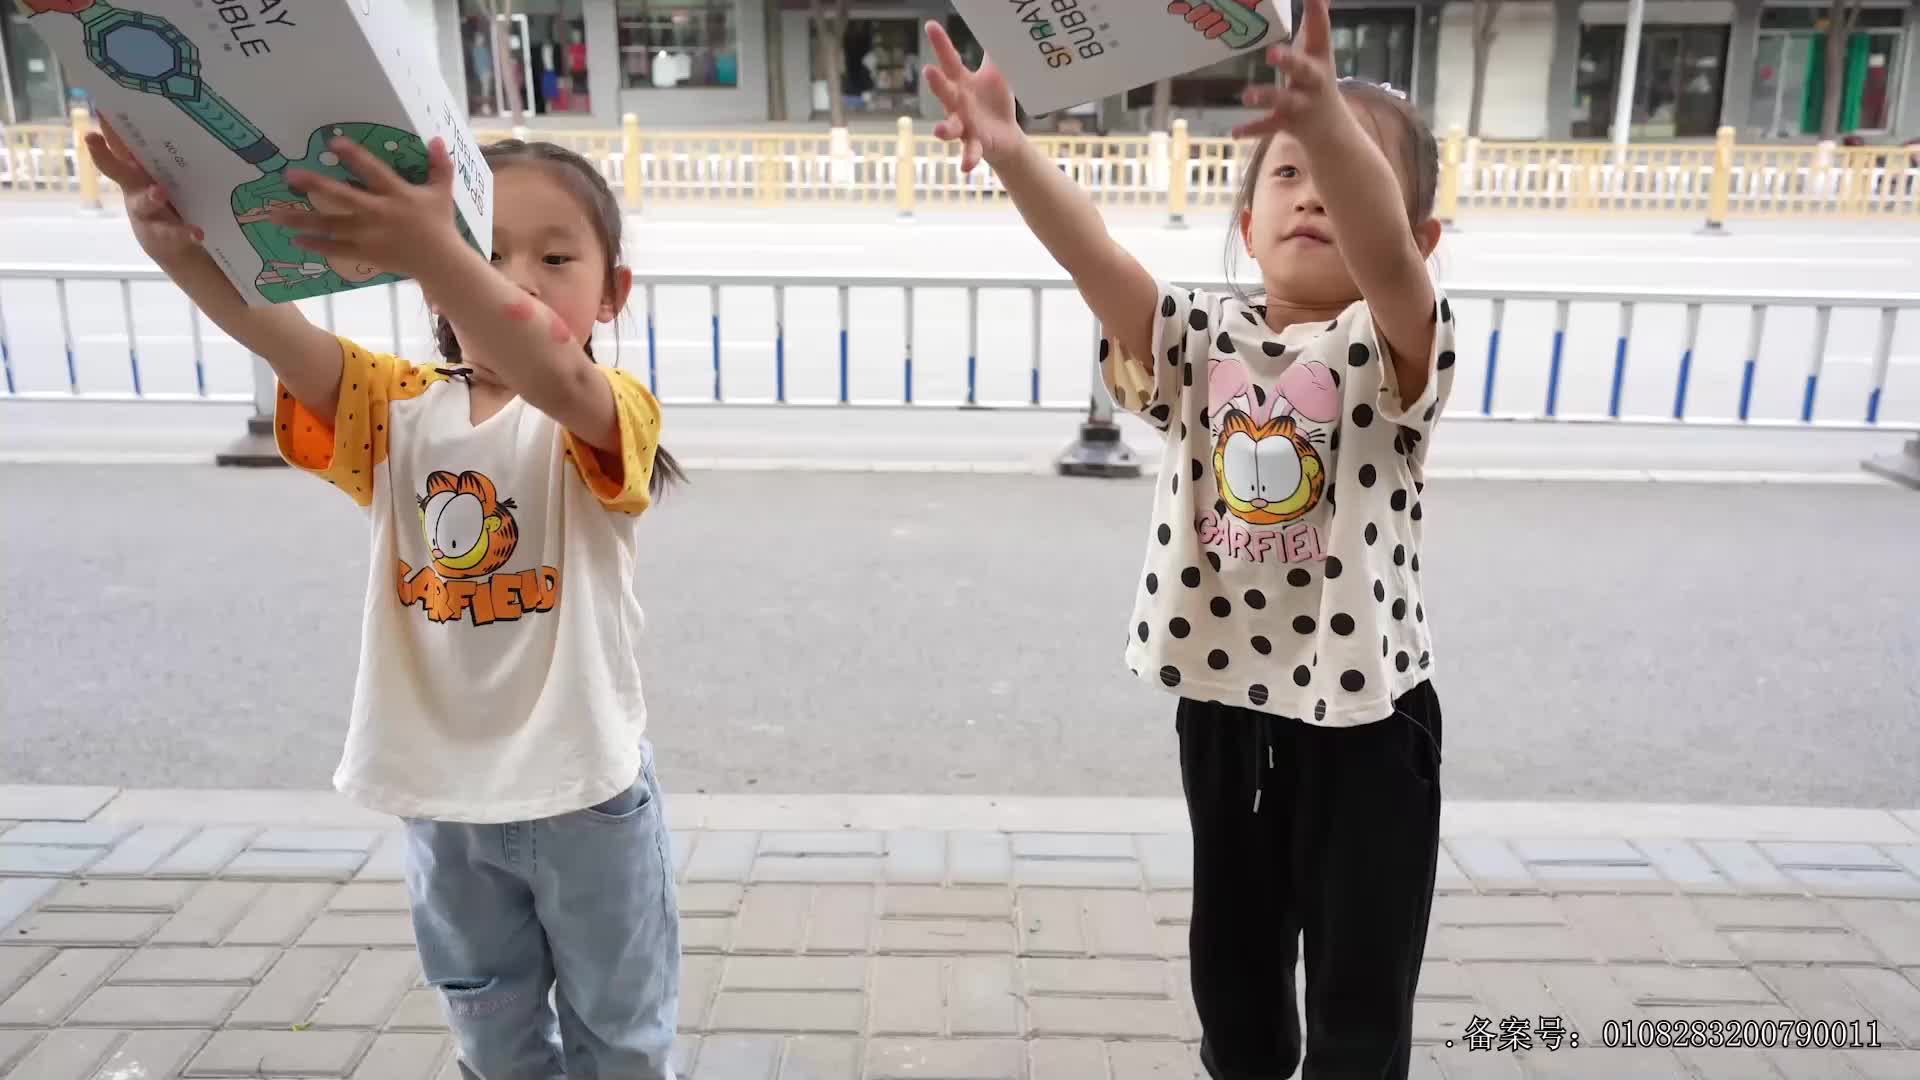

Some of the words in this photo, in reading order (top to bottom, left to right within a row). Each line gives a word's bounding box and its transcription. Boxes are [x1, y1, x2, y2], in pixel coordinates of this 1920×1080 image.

[211, 0, 271, 57] BLE
[1008, 0, 1072, 69] SPRAY
[1194, 510, 1329, 564] GARFIEL
